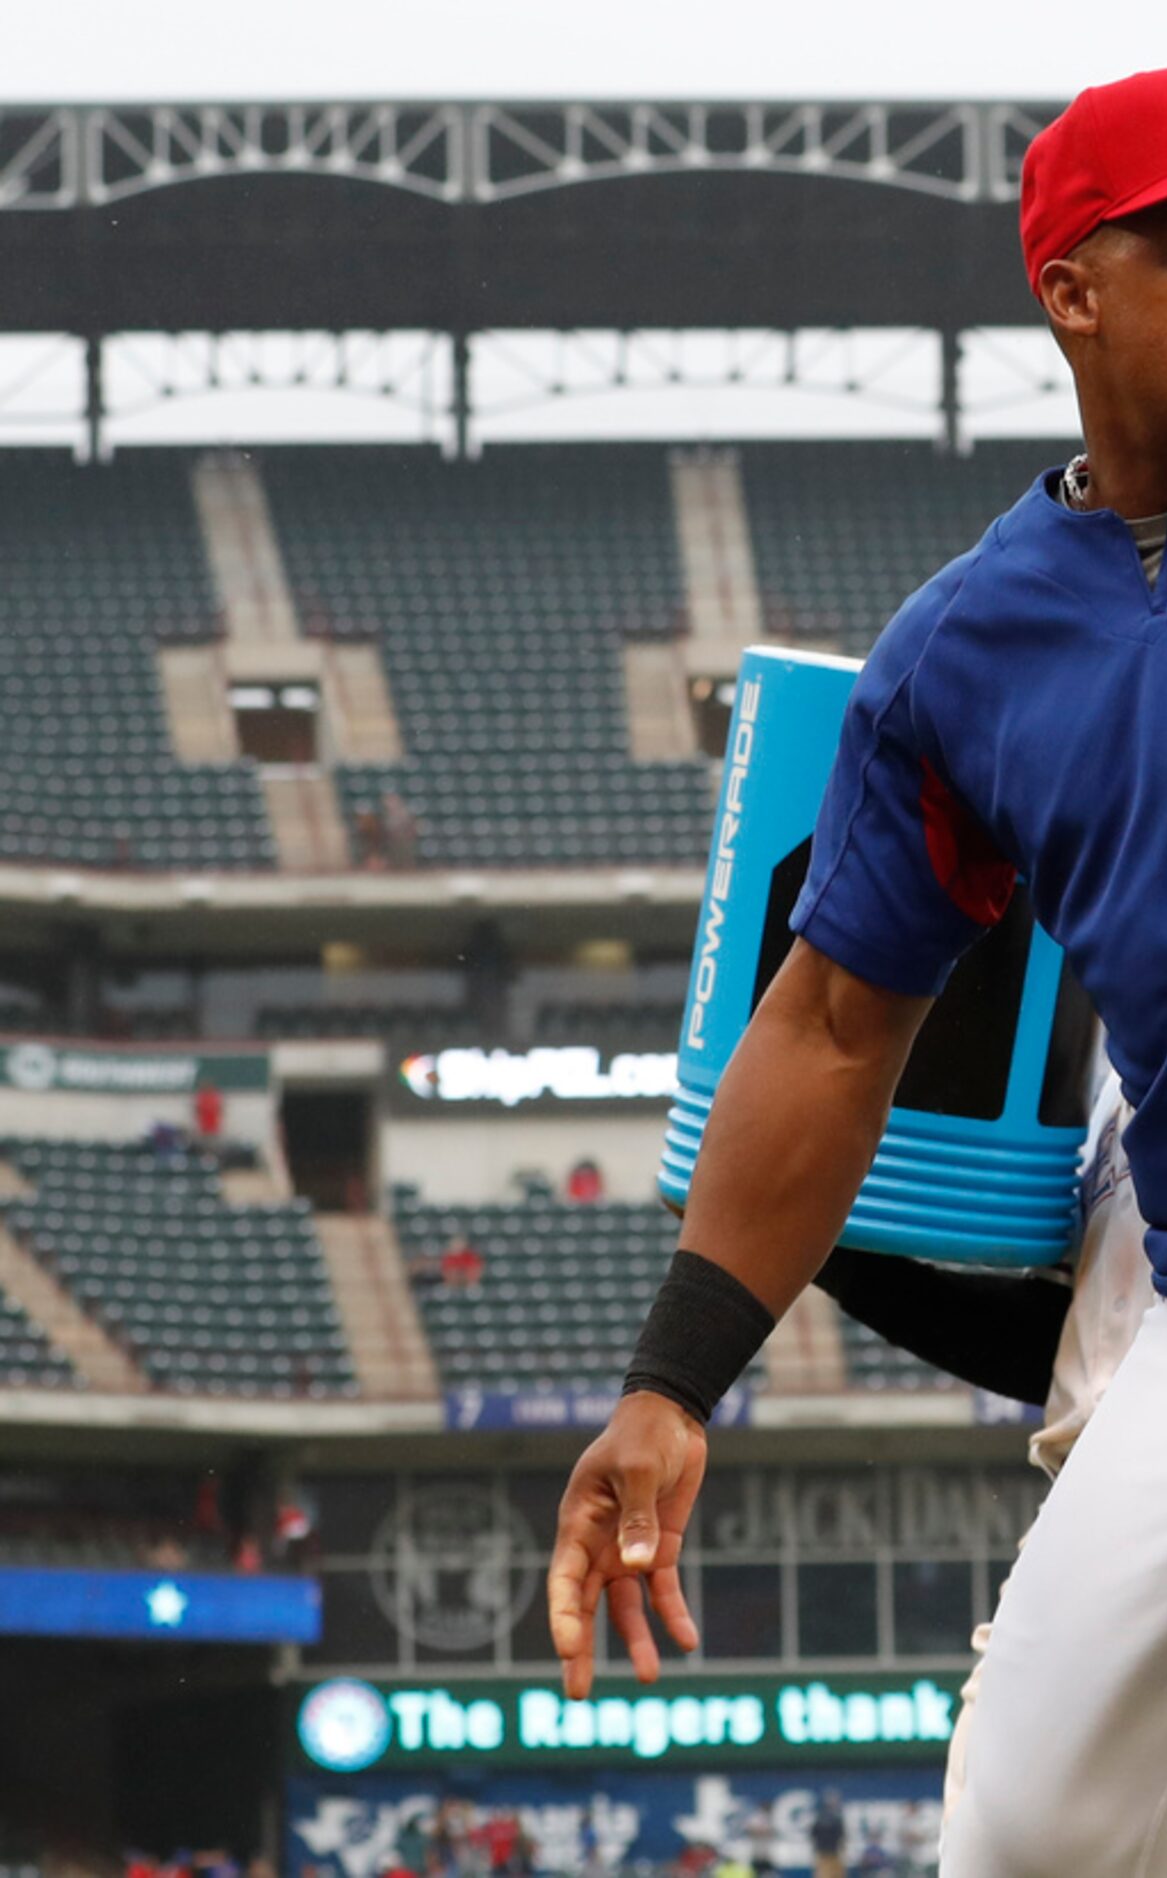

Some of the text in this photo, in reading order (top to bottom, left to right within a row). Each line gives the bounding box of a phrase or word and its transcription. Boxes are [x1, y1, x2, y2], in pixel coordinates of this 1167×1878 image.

[687, 681, 762, 1050] POWERADE
[389, 1688, 504, 1750] The
[519, 1688, 765, 1758] Rangers
[778, 1679, 954, 1743] thank
